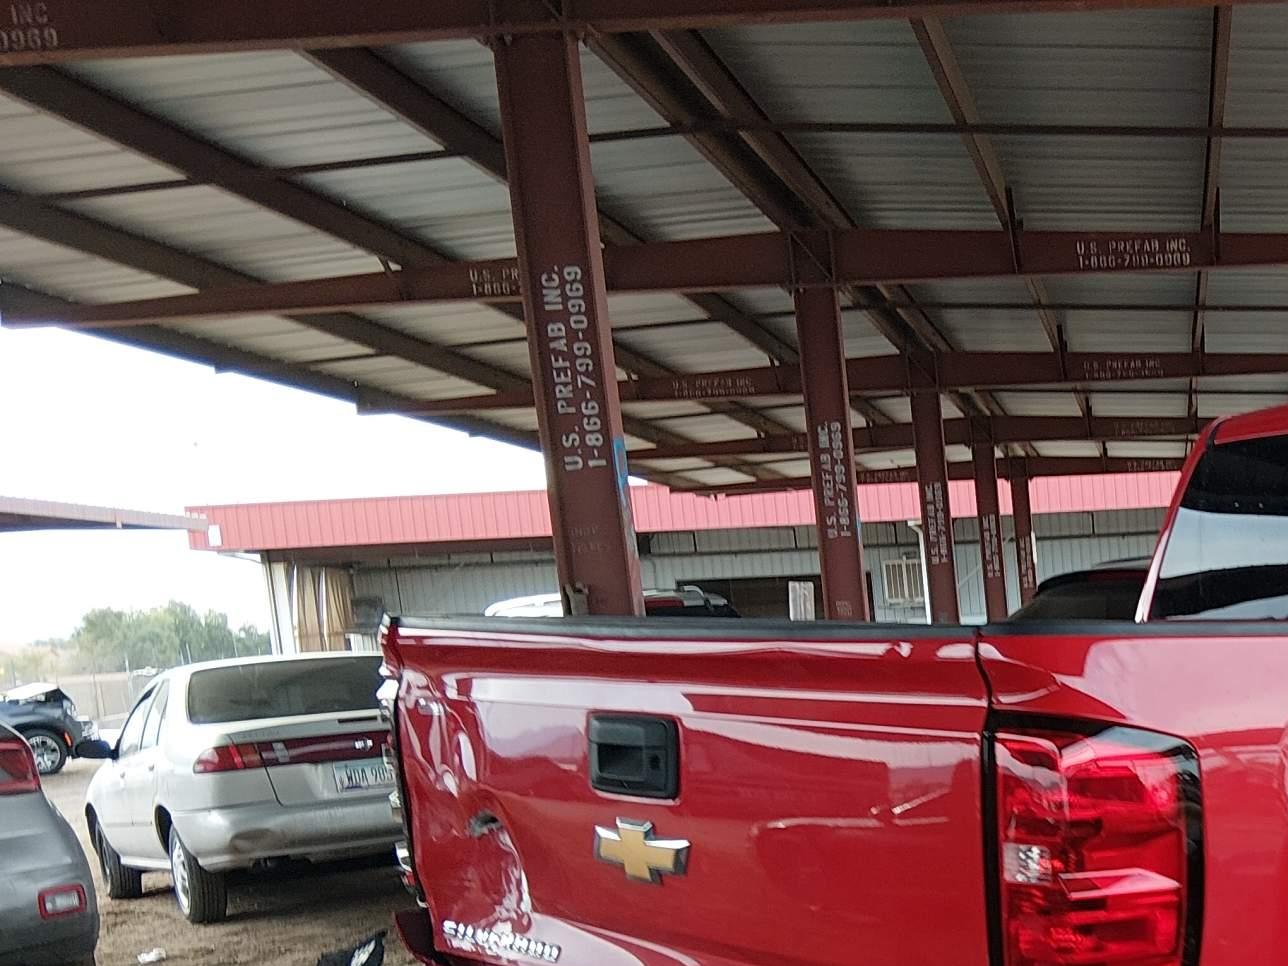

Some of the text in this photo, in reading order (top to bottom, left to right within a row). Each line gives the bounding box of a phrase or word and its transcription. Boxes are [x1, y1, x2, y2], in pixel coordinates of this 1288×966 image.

[541, 265, 584, 471] U.S. PREFAB INC.
[563, 265, 607, 468] 1-866-799-0969
